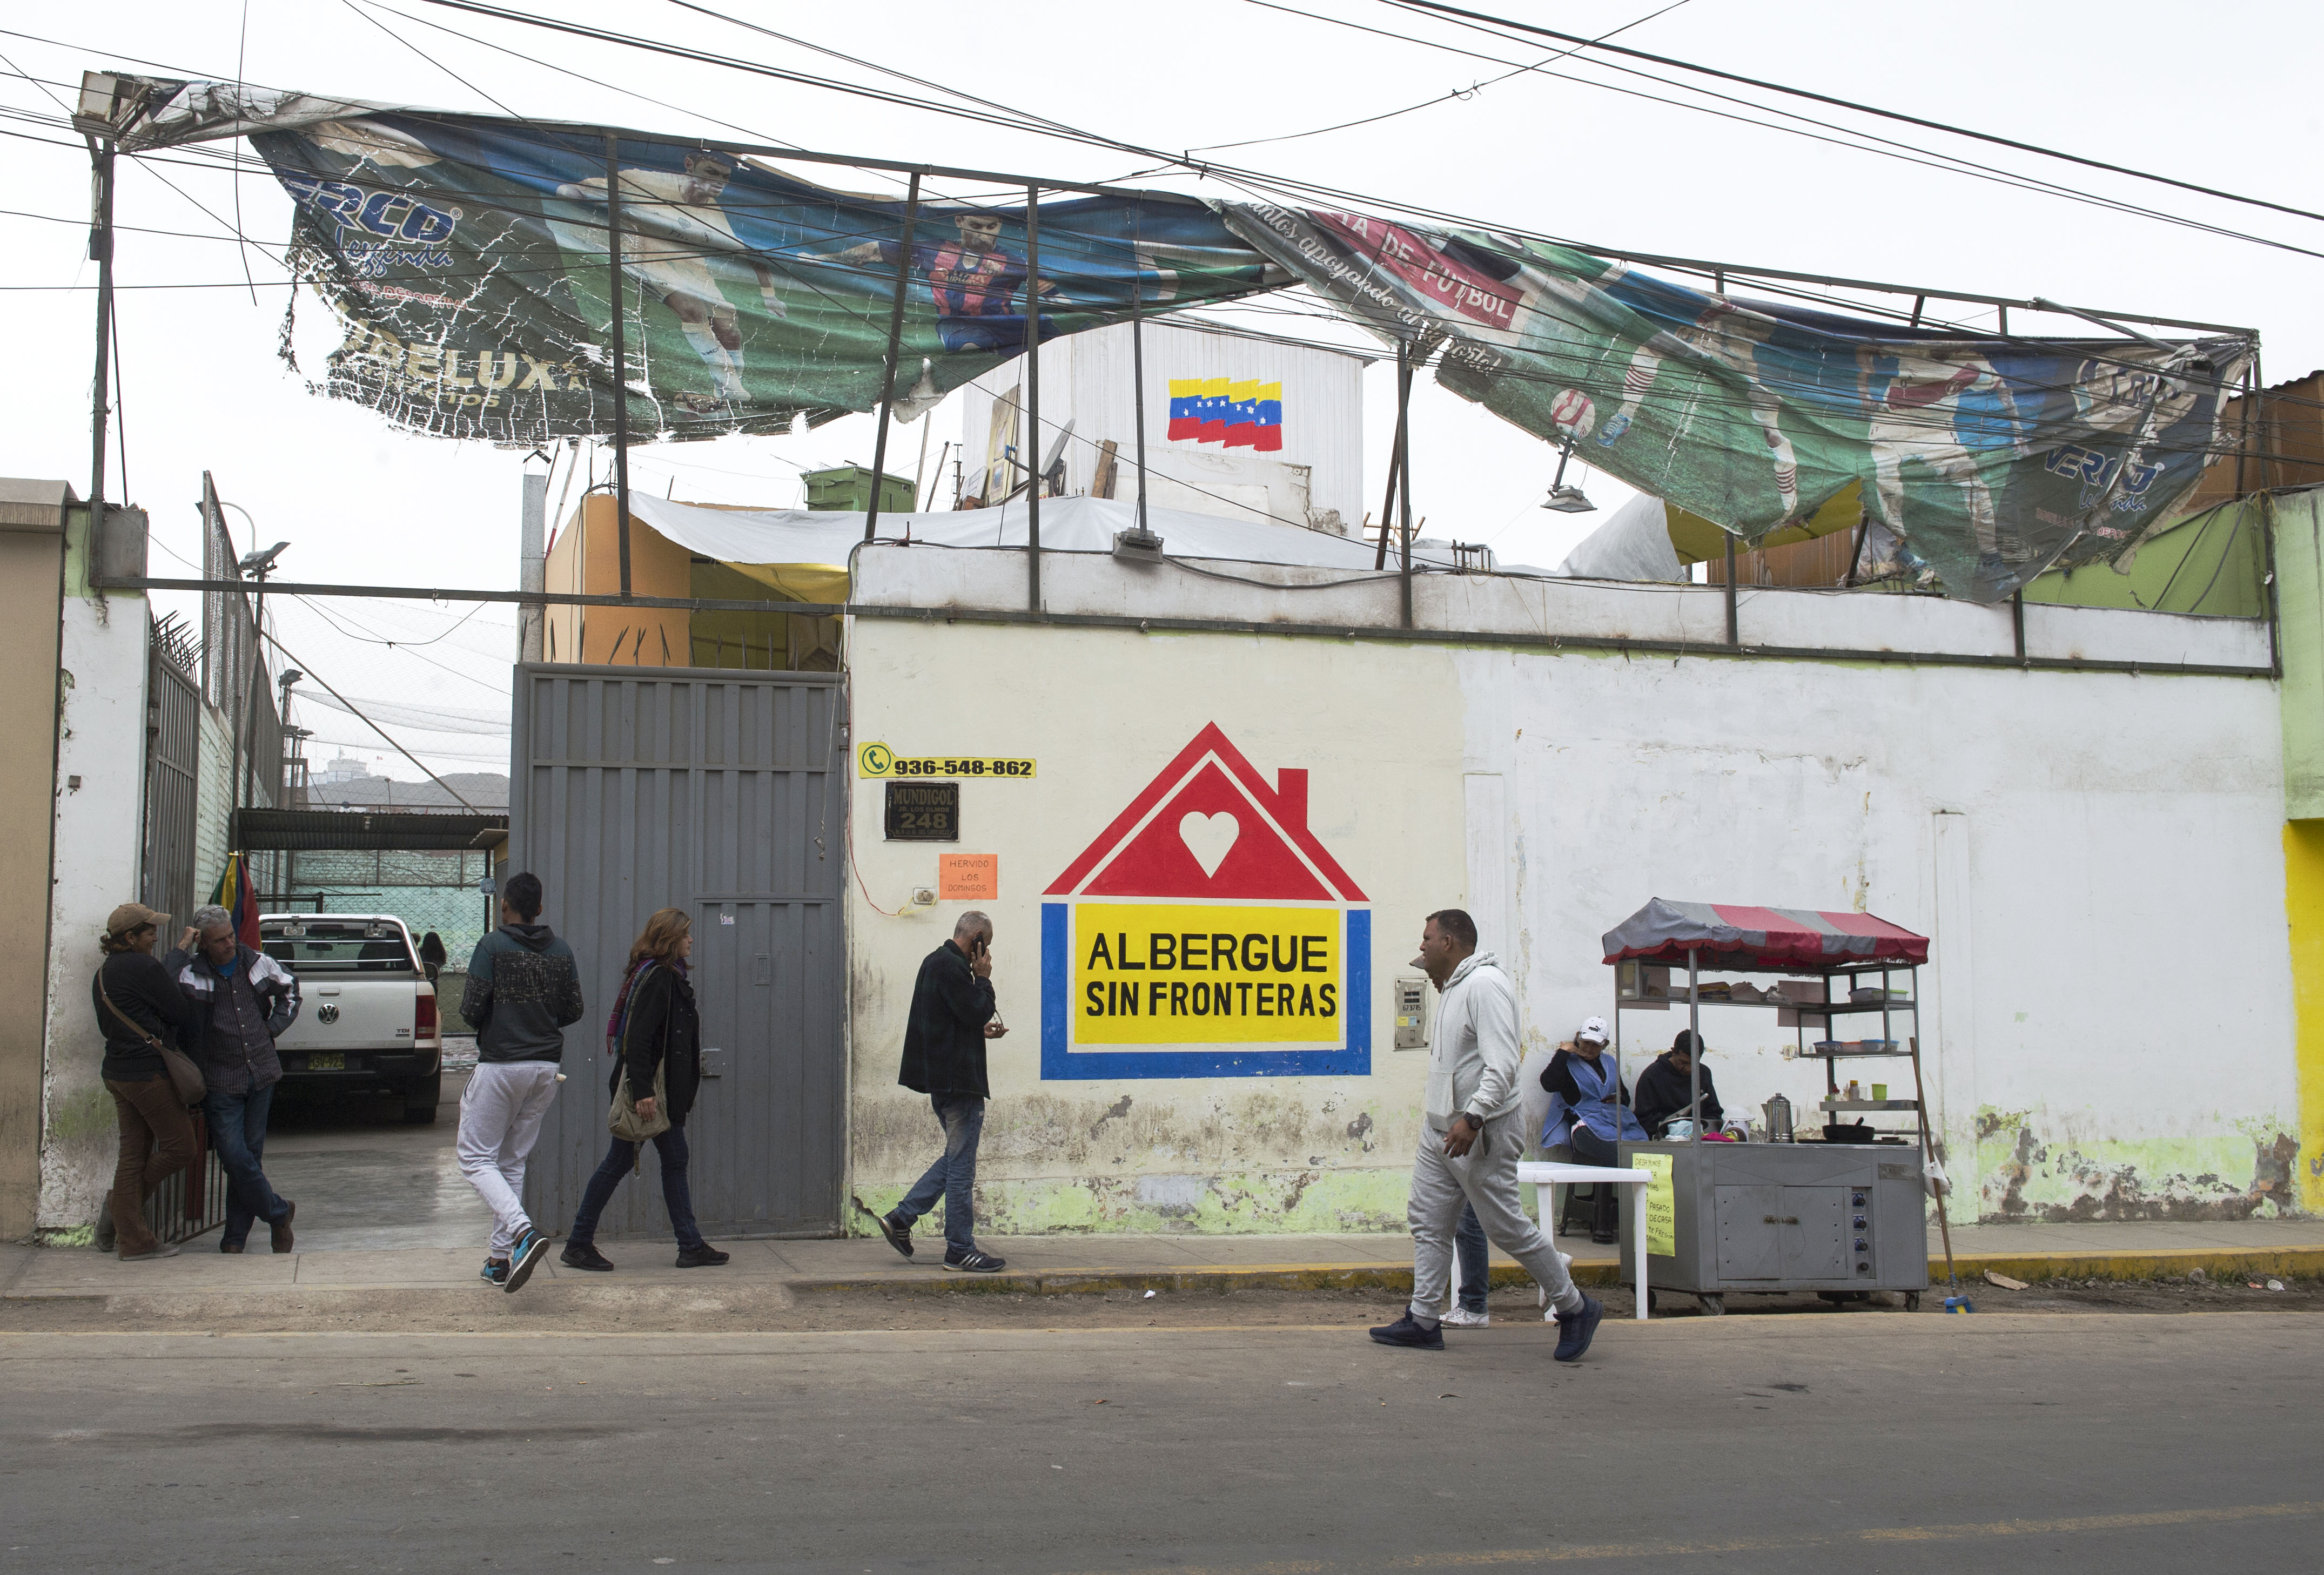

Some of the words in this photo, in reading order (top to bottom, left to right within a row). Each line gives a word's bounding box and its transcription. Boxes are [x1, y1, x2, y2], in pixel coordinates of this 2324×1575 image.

[1298, 234, 1397, 307] apoyando
[1382, 233, 1414, 268] DE
[1422, 260, 1509, 319] FUTBOL
[895, 760, 1032, 776] 936-548-862
[894, 788, 953, 805] MUNDIGOL
[901, 812, 948, 829] 248
[950, 859, 989, 867] HERVIDO
[1087, 932, 1328, 973] ALBERGUE
[1086, 981, 1138, 1017] SIN
[1148, 981, 1336, 1018] FRONTERAS
[1649, 1202, 1670, 1213] PASADO
